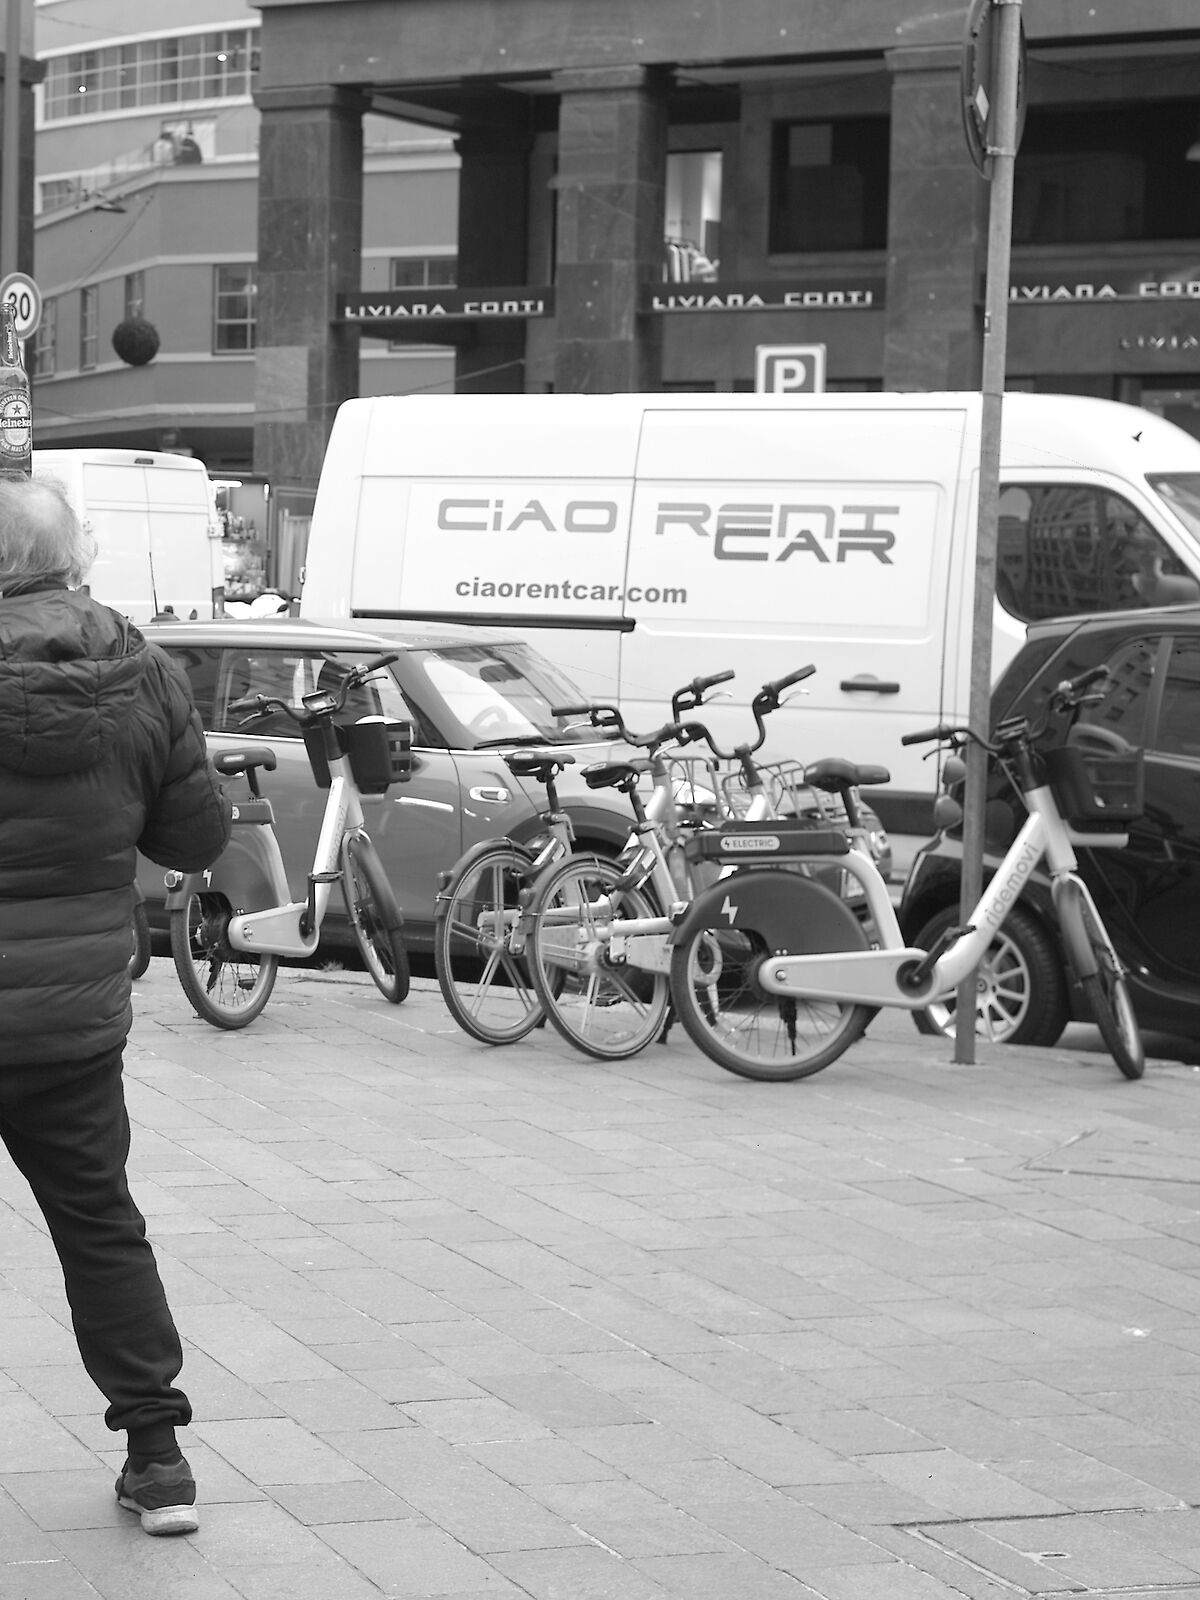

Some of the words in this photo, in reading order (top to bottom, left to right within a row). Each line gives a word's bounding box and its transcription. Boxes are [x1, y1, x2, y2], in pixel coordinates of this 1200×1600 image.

[7, 292, 31, 321] 30
[345, 303, 447, 318] LIVIANA
[464, 300, 544, 315] CONTI
[652, 294, 765, 310] LIVIANA
[784, 290, 873, 306] CONTI
[773, 359, 807, 393] P
[713, 528, 896, 565] CAR
[455, 577, 688, 604] ciaorentcar.com
[732, 838, 775, 849] ELECTRIC
[985, 841, 1040, 927] ridemovi
